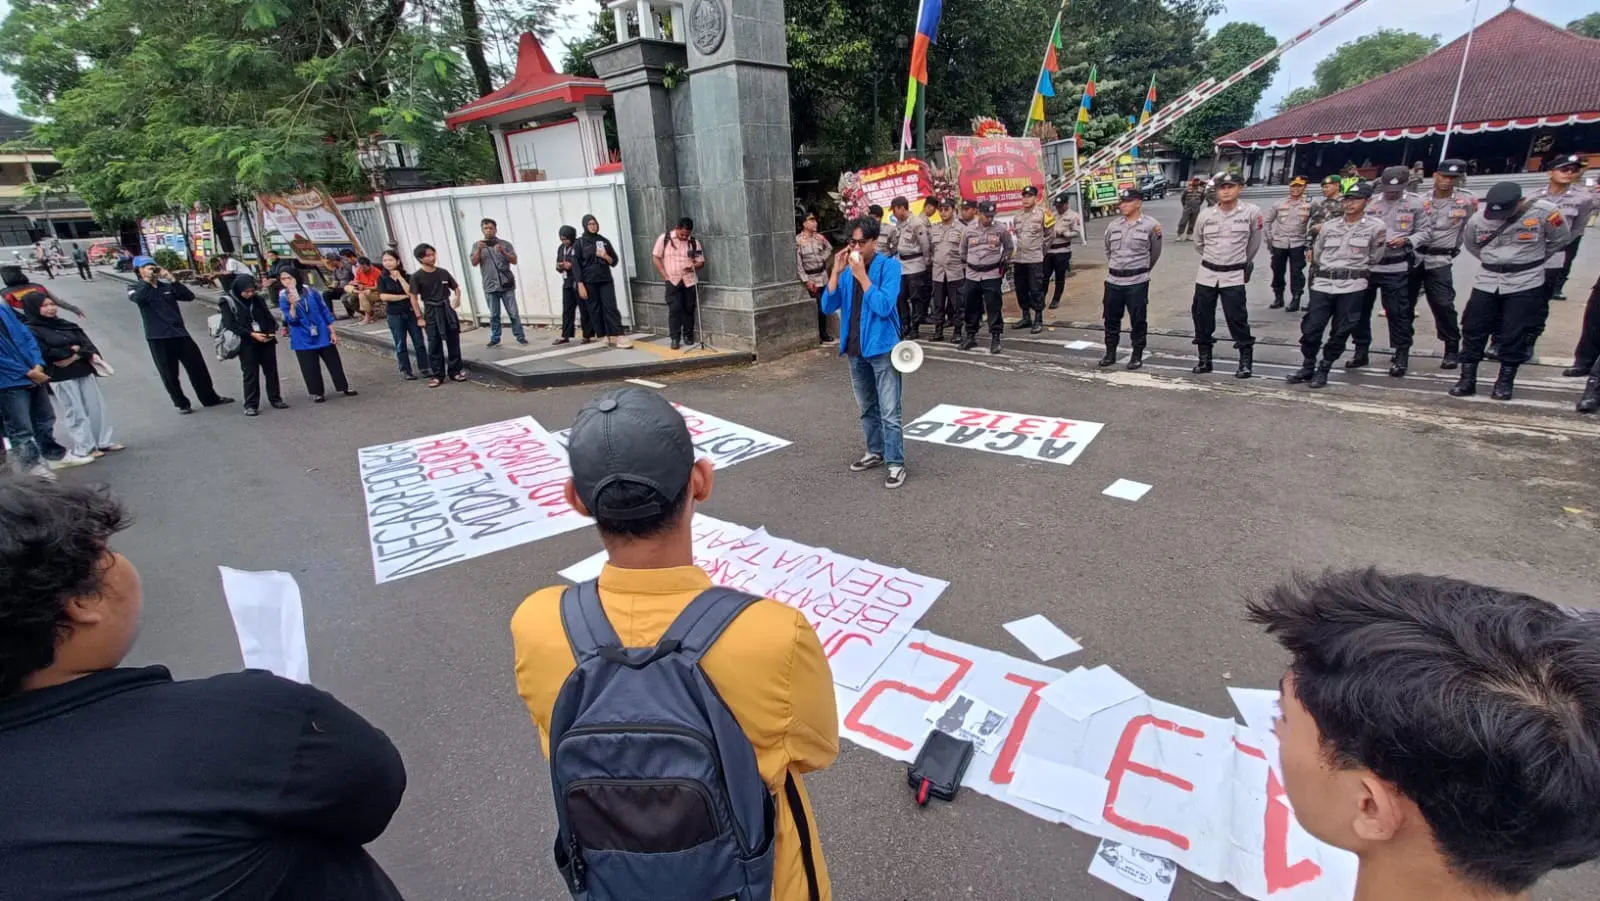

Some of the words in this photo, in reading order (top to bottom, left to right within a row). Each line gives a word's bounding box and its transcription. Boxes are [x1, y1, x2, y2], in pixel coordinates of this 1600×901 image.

[362, 445, 428, 494] BONEKA
[370, 484, 466, 579] NEGARA
[439, 472, 534, 540] MODAL
